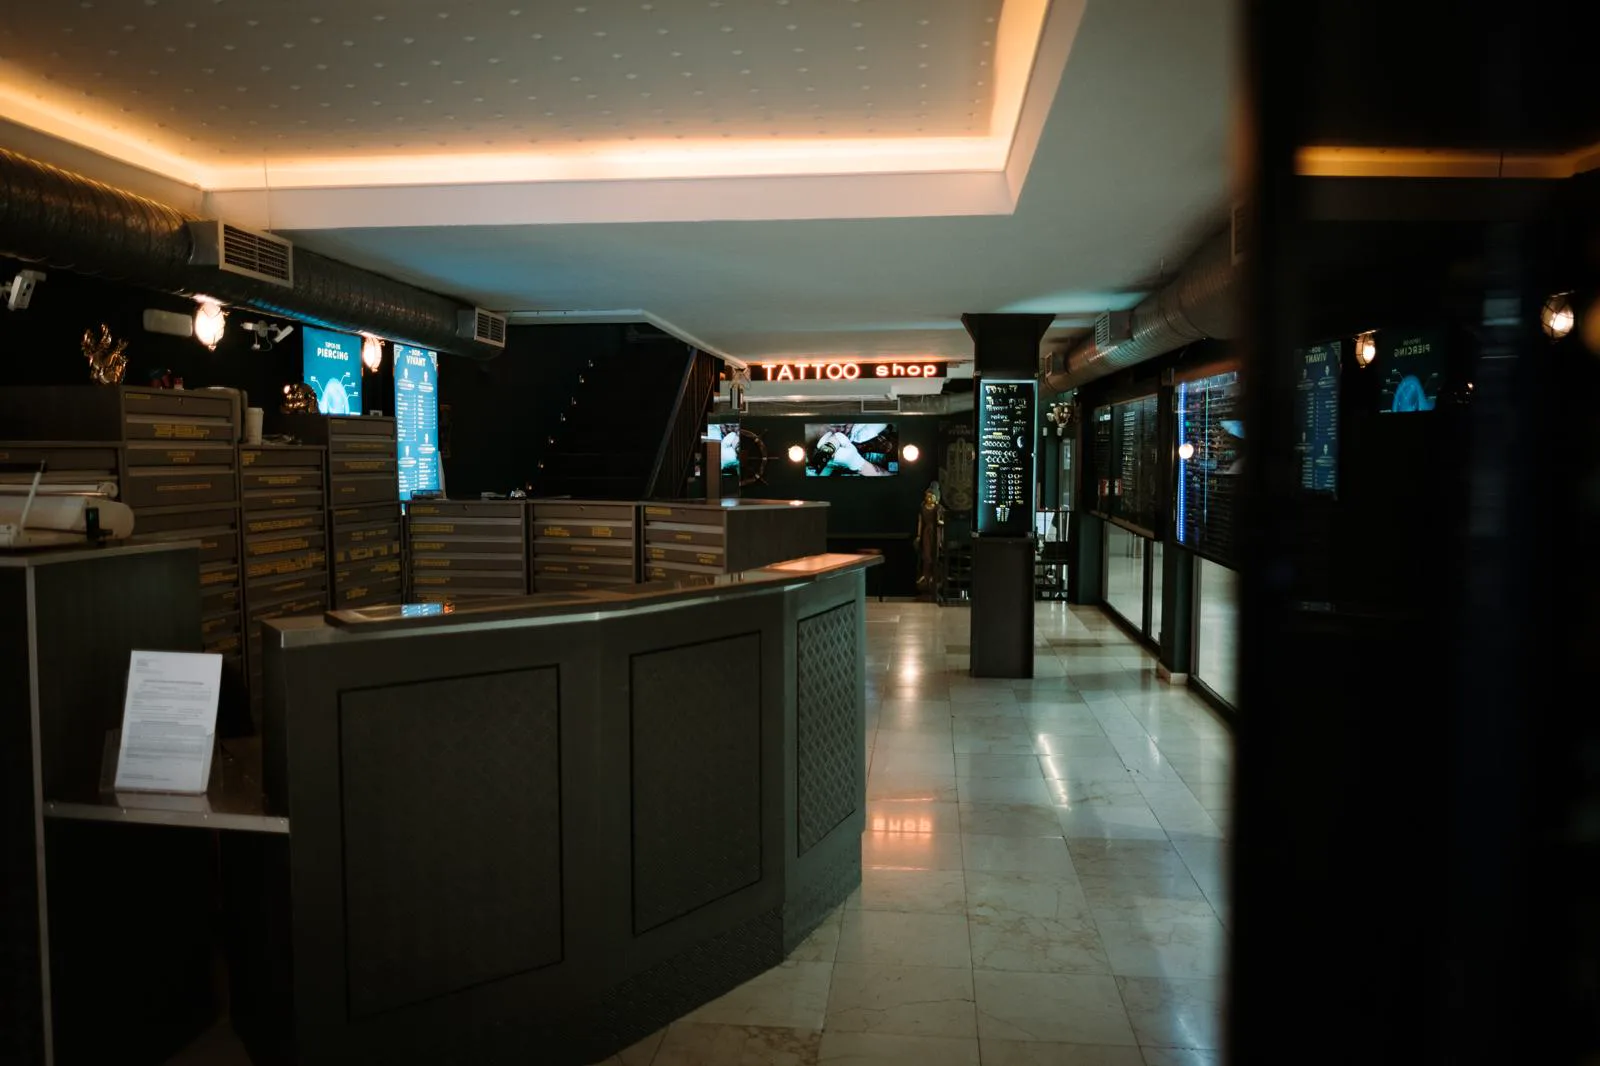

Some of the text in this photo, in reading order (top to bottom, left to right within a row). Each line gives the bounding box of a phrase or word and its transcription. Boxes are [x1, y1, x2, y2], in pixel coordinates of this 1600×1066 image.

[317, 347, 349, 361] PIERCING
[761, 362, 937, 381] TATTOO shop
